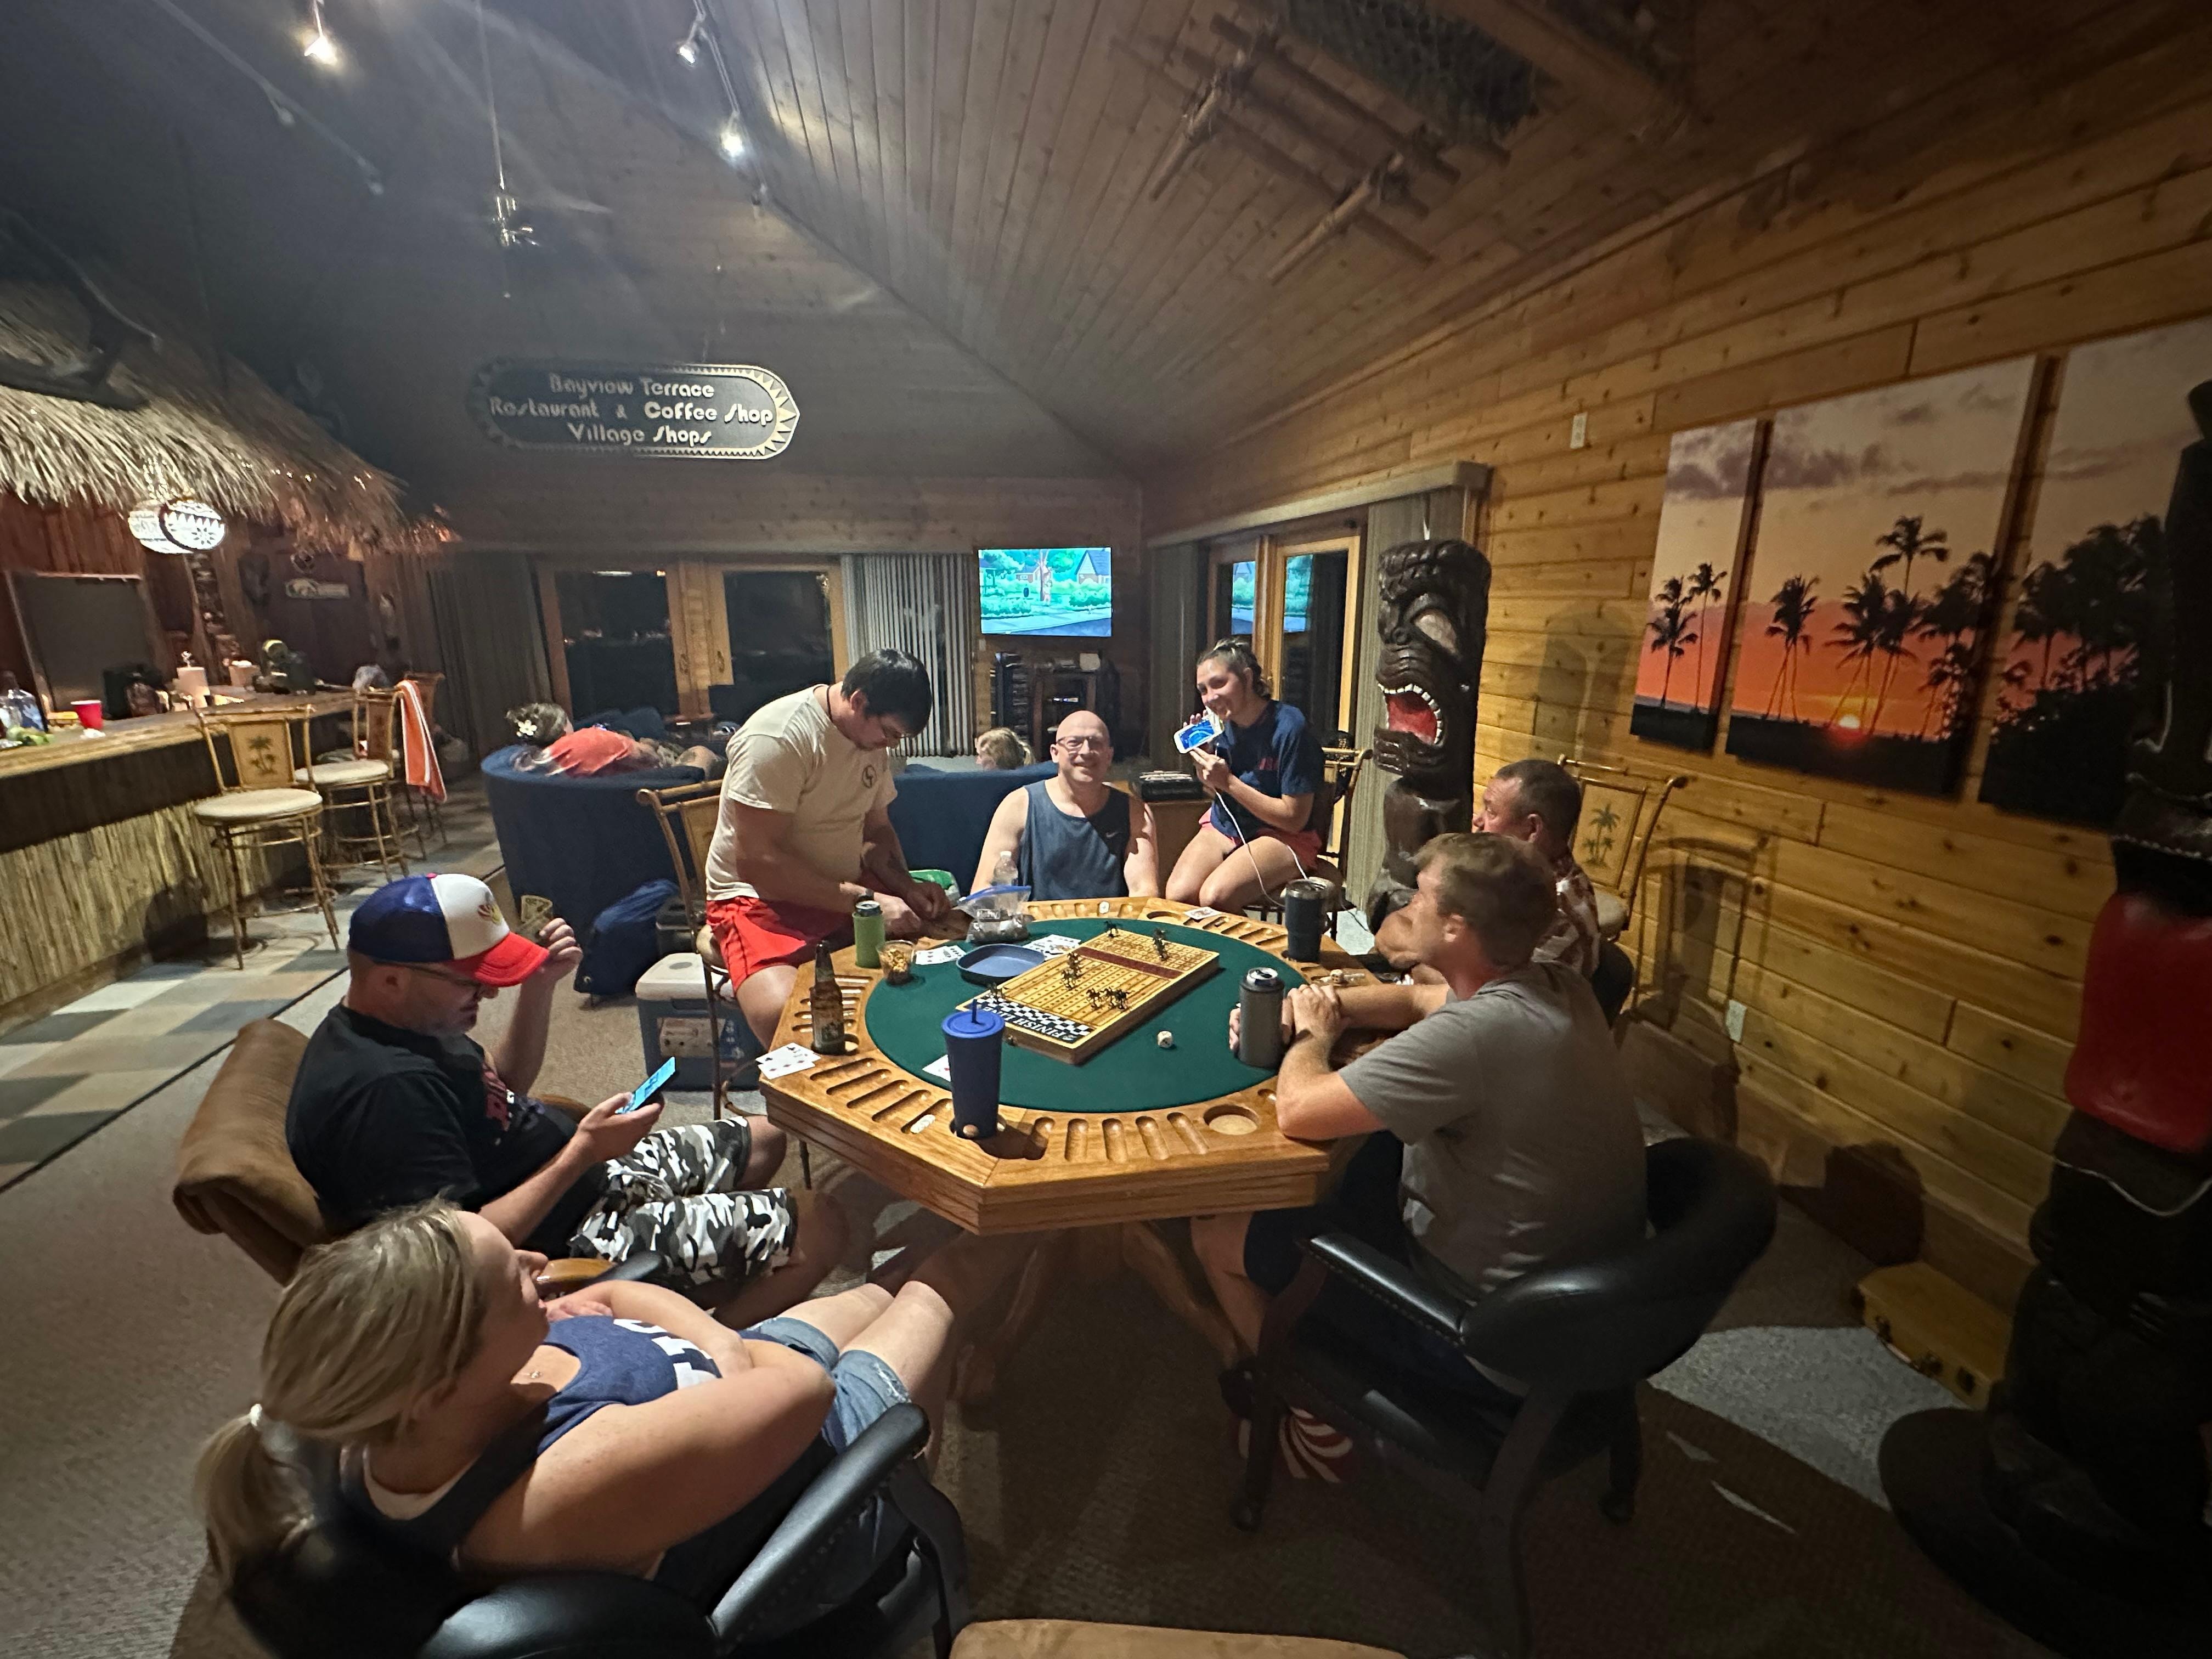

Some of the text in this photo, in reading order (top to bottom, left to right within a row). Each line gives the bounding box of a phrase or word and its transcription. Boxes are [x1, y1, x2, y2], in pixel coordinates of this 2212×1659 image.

[549, 373, 714, 399] Bayview Terrace
[490, 397, 773, 426] Restaurant & Coffee Shop
[567, 422, 712, 447] Village Shops
[1013, 1018, 1066, 1038] FINISH
